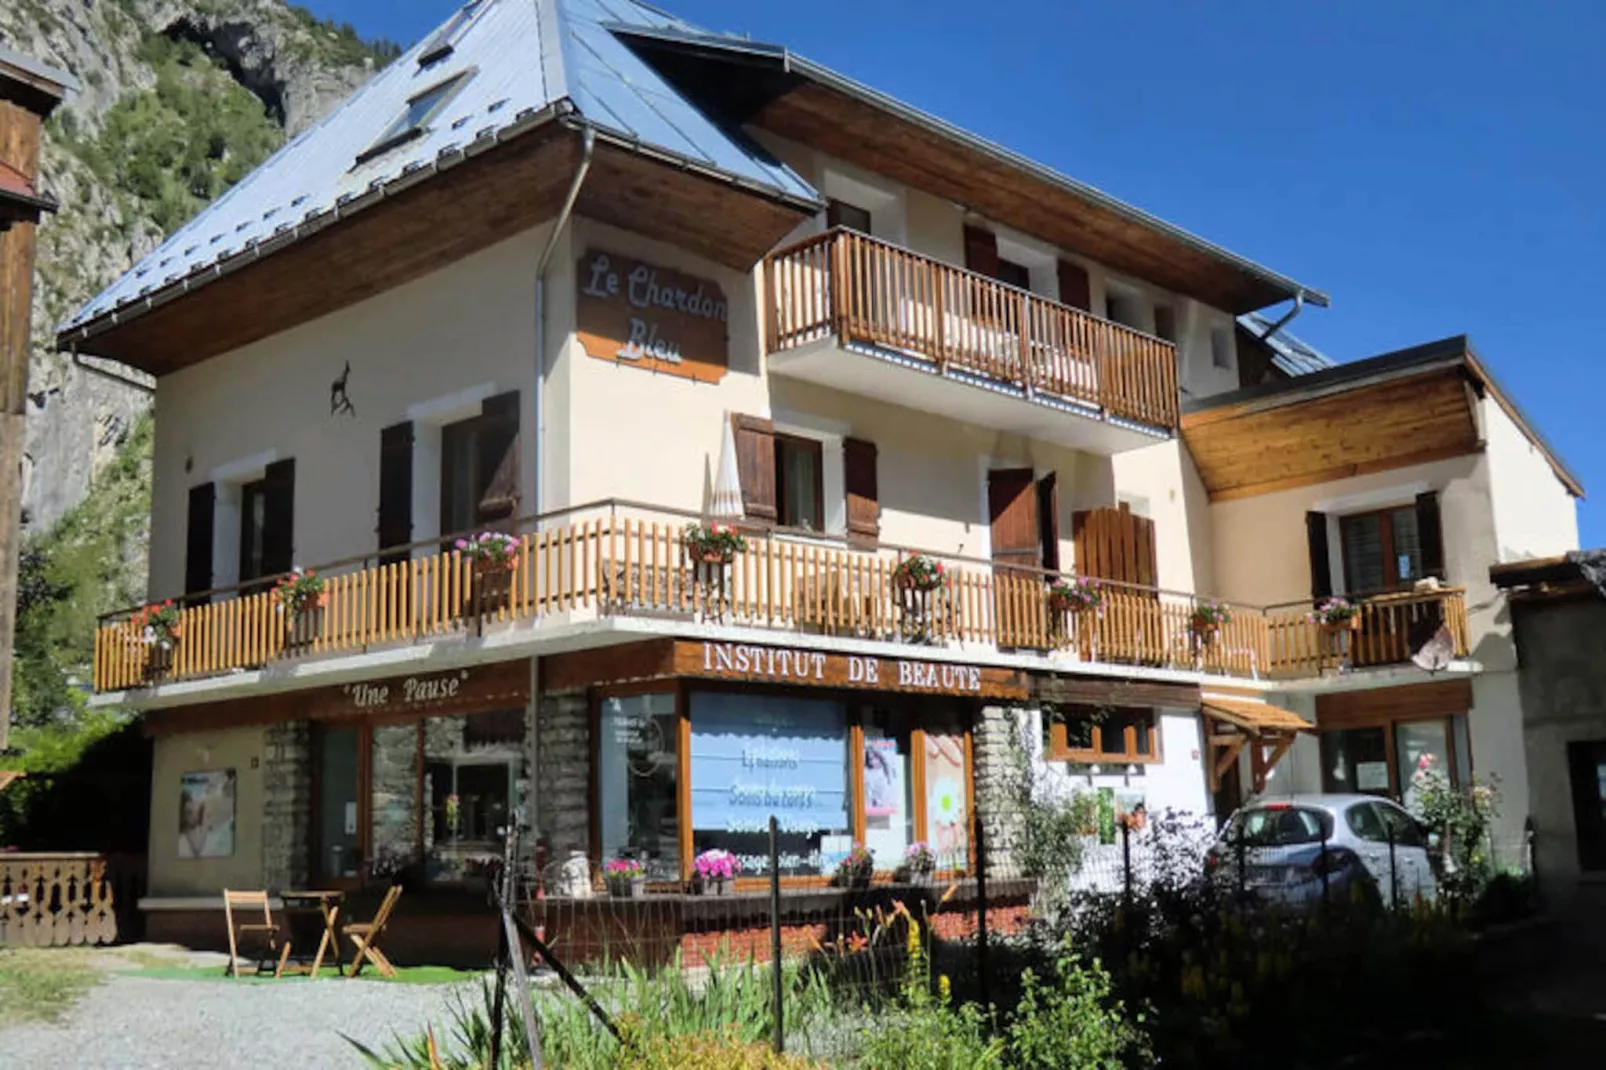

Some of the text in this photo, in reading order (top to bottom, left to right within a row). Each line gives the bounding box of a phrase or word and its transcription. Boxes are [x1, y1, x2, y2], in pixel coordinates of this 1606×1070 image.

[582, 254, 727, 322] Le Chardon
[616, 318, 683, 365] Bleu
[703, 641, 981, 690] INSTITUT DE BEAUTE
